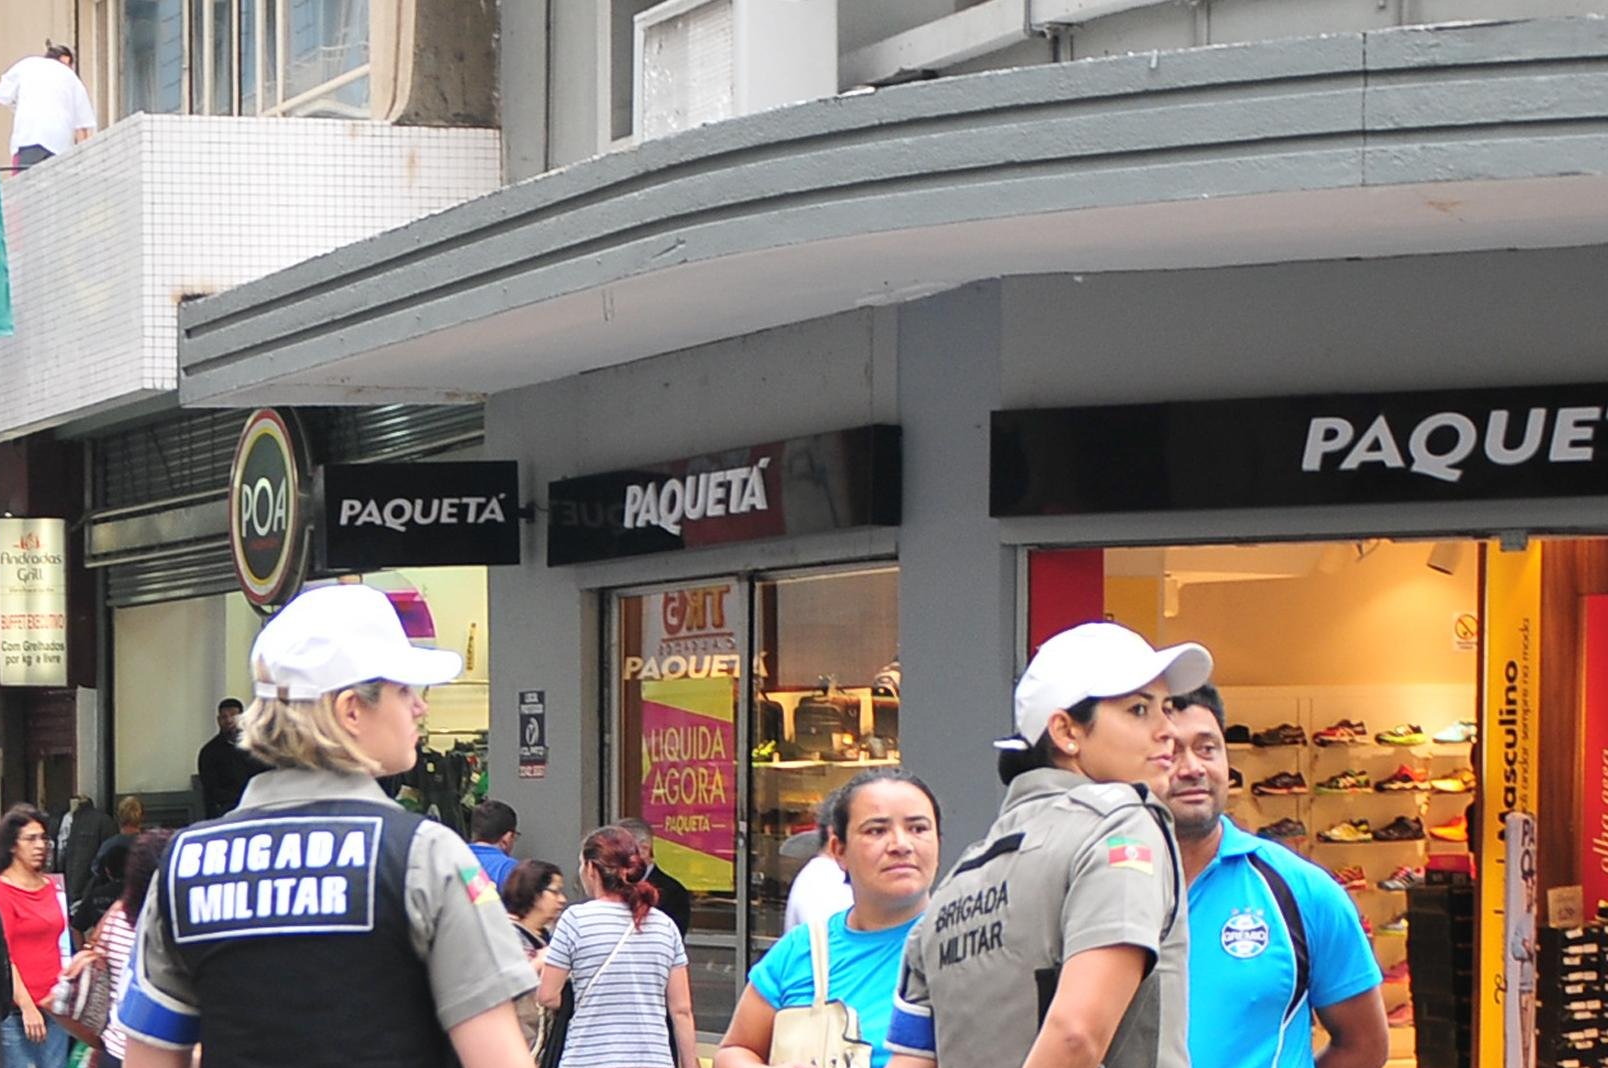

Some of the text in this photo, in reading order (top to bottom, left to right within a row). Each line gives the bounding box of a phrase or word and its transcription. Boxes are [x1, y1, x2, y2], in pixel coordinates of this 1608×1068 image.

[1301, 406, 1608, 482] PAQUE
[241, 476, 287, 538] POA
[339, 492, 507, 532] PAQUETÁ
[623, 456, 771, 536] PAQUETÁ
[0, 551, 63, 565] Andradas
[16, 567, 44, 584] Grill
[650, 725, 727, 763] LIQUIDA
[650, 766, 727, 806] AGORA
[664, 813, 711, 837] PAQUETÁ
[177, 831, 366, 879] BRIGADA
[189, 876, 349, 925] MILITAR
[935, 880, 1009, 934] BRIGADA
[938, 920, 1004, 971] MILITAR
